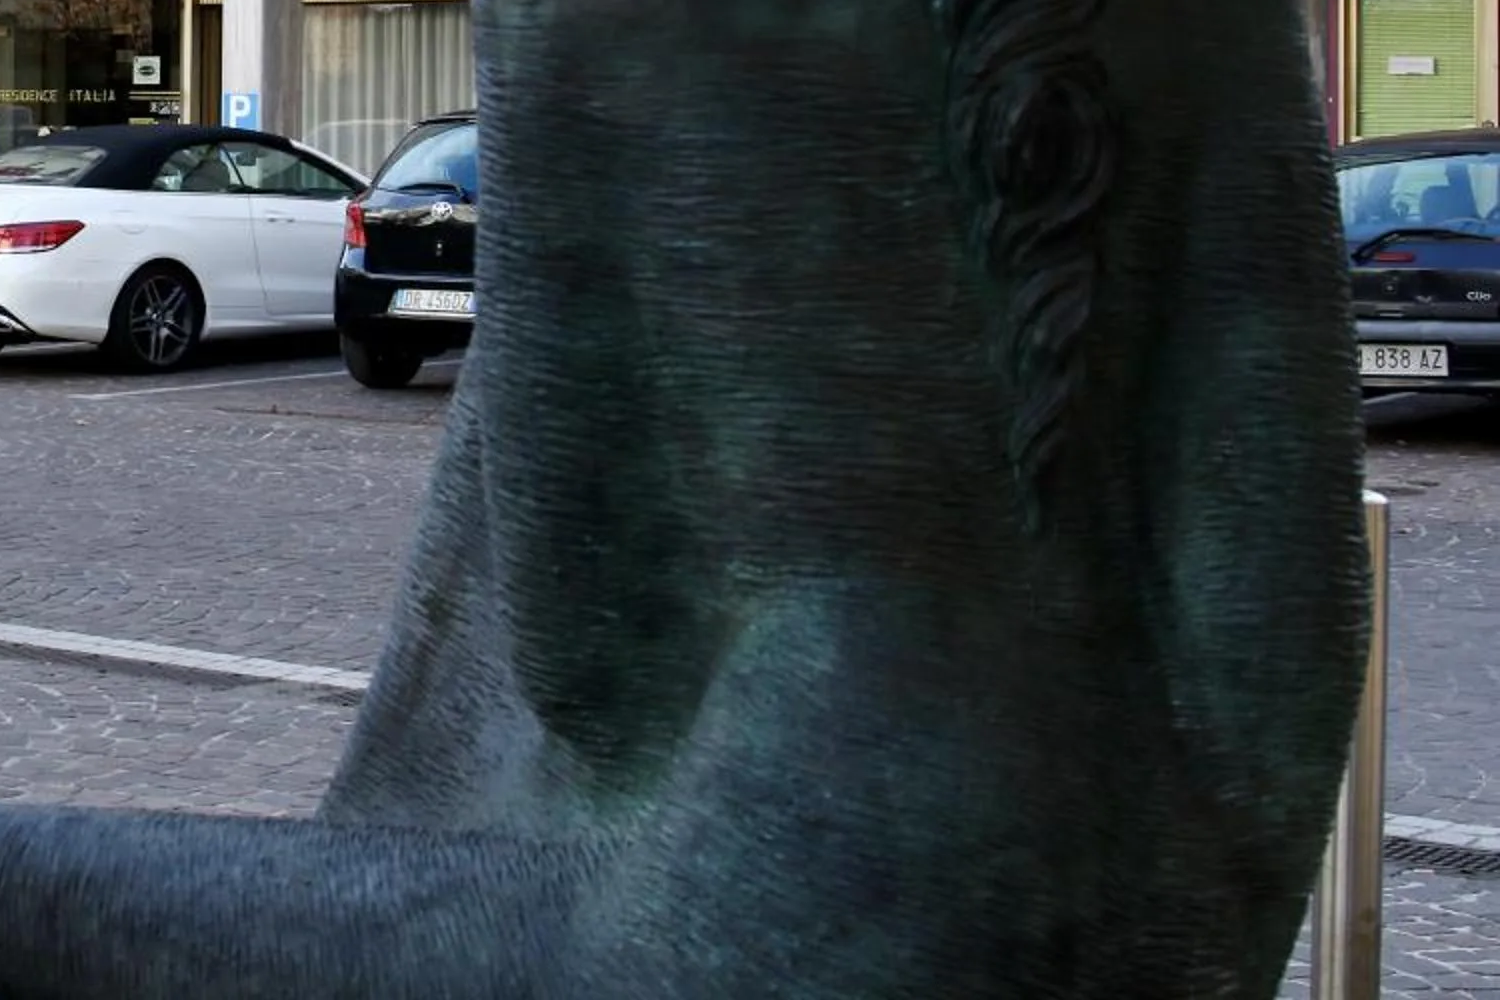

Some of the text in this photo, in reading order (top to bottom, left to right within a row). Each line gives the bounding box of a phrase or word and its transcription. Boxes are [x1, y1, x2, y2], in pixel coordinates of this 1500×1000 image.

[69, 88, 116, 102] ITALIA
[230, 95, 251, 128] P
[1375, 347, 1411, 369] 838
[1419, 348, 1443, 369] AZ
